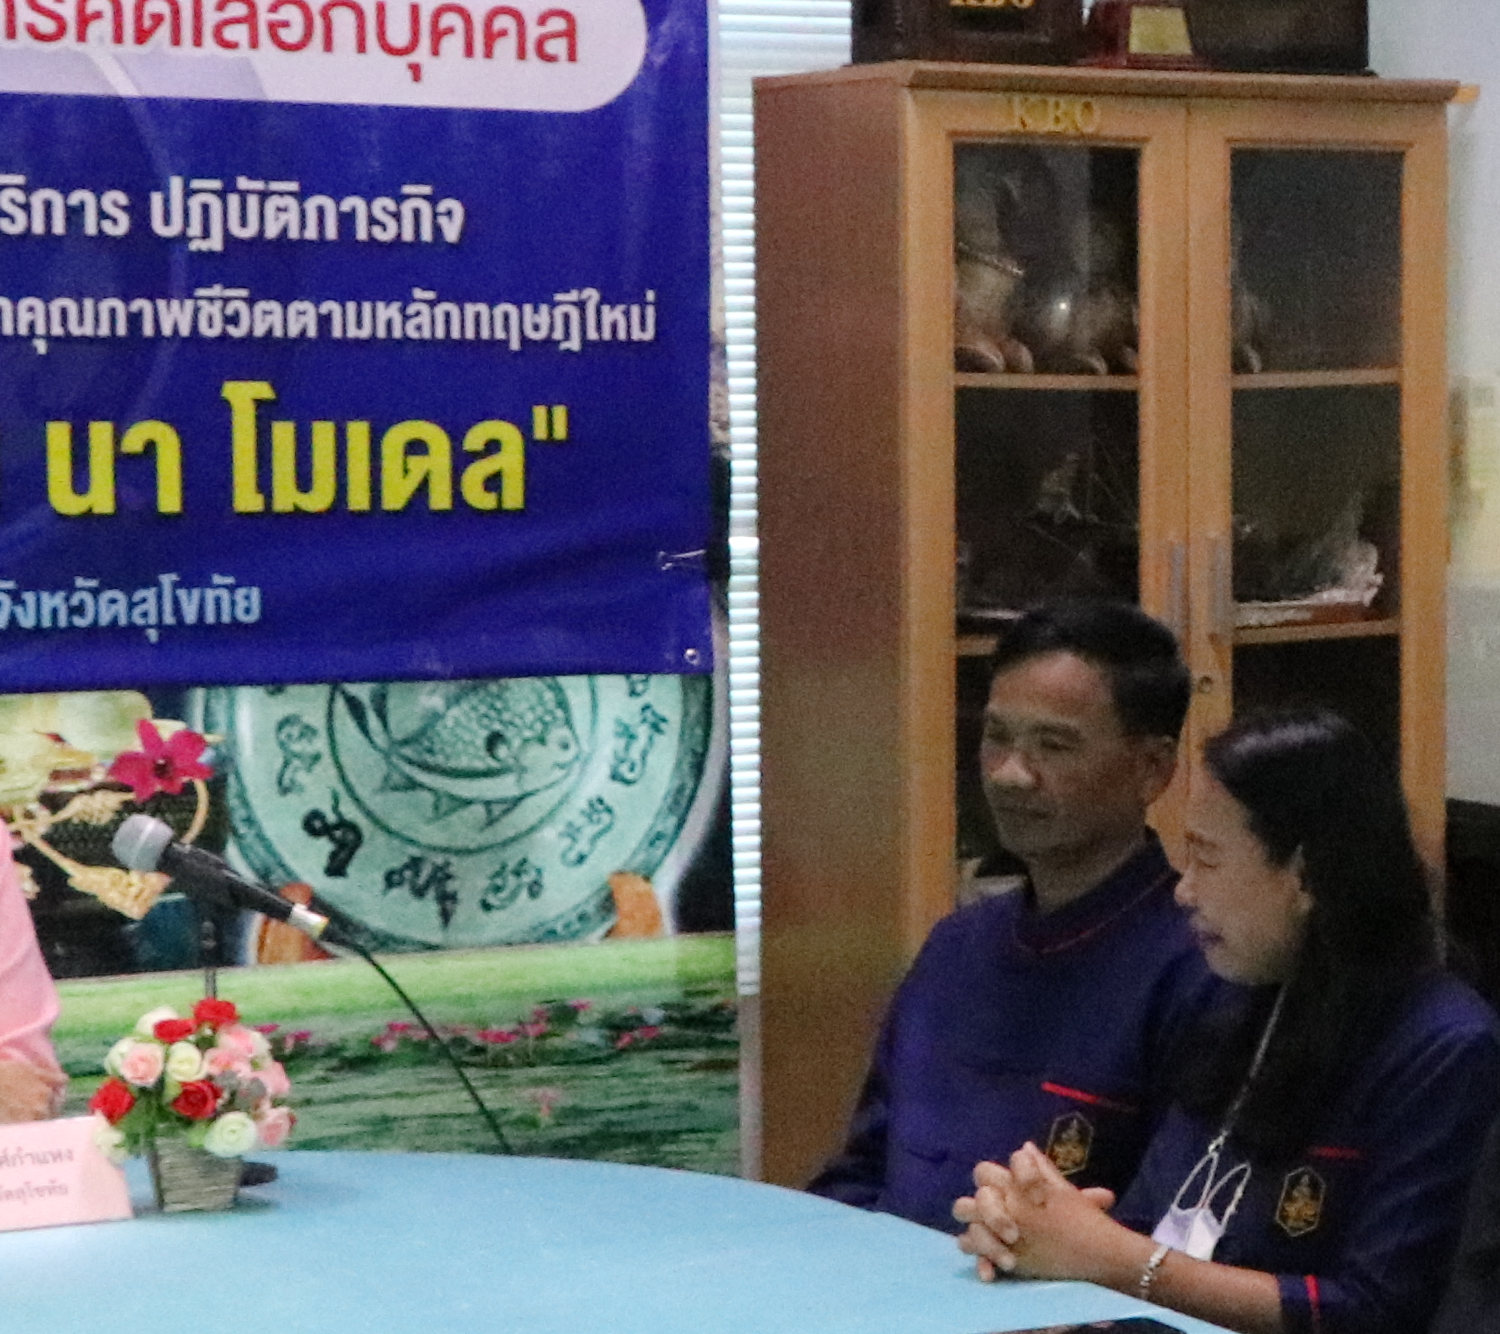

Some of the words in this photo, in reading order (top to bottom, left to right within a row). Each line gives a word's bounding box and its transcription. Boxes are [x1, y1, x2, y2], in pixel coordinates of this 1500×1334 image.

[1004, 94, 1100, 134] KBO
[149, 175, 466, 252] ปฏิบัติภารกิจ
[46, 420, 183, 515] นา
[221, 380, 568, 514] โมเดล"
